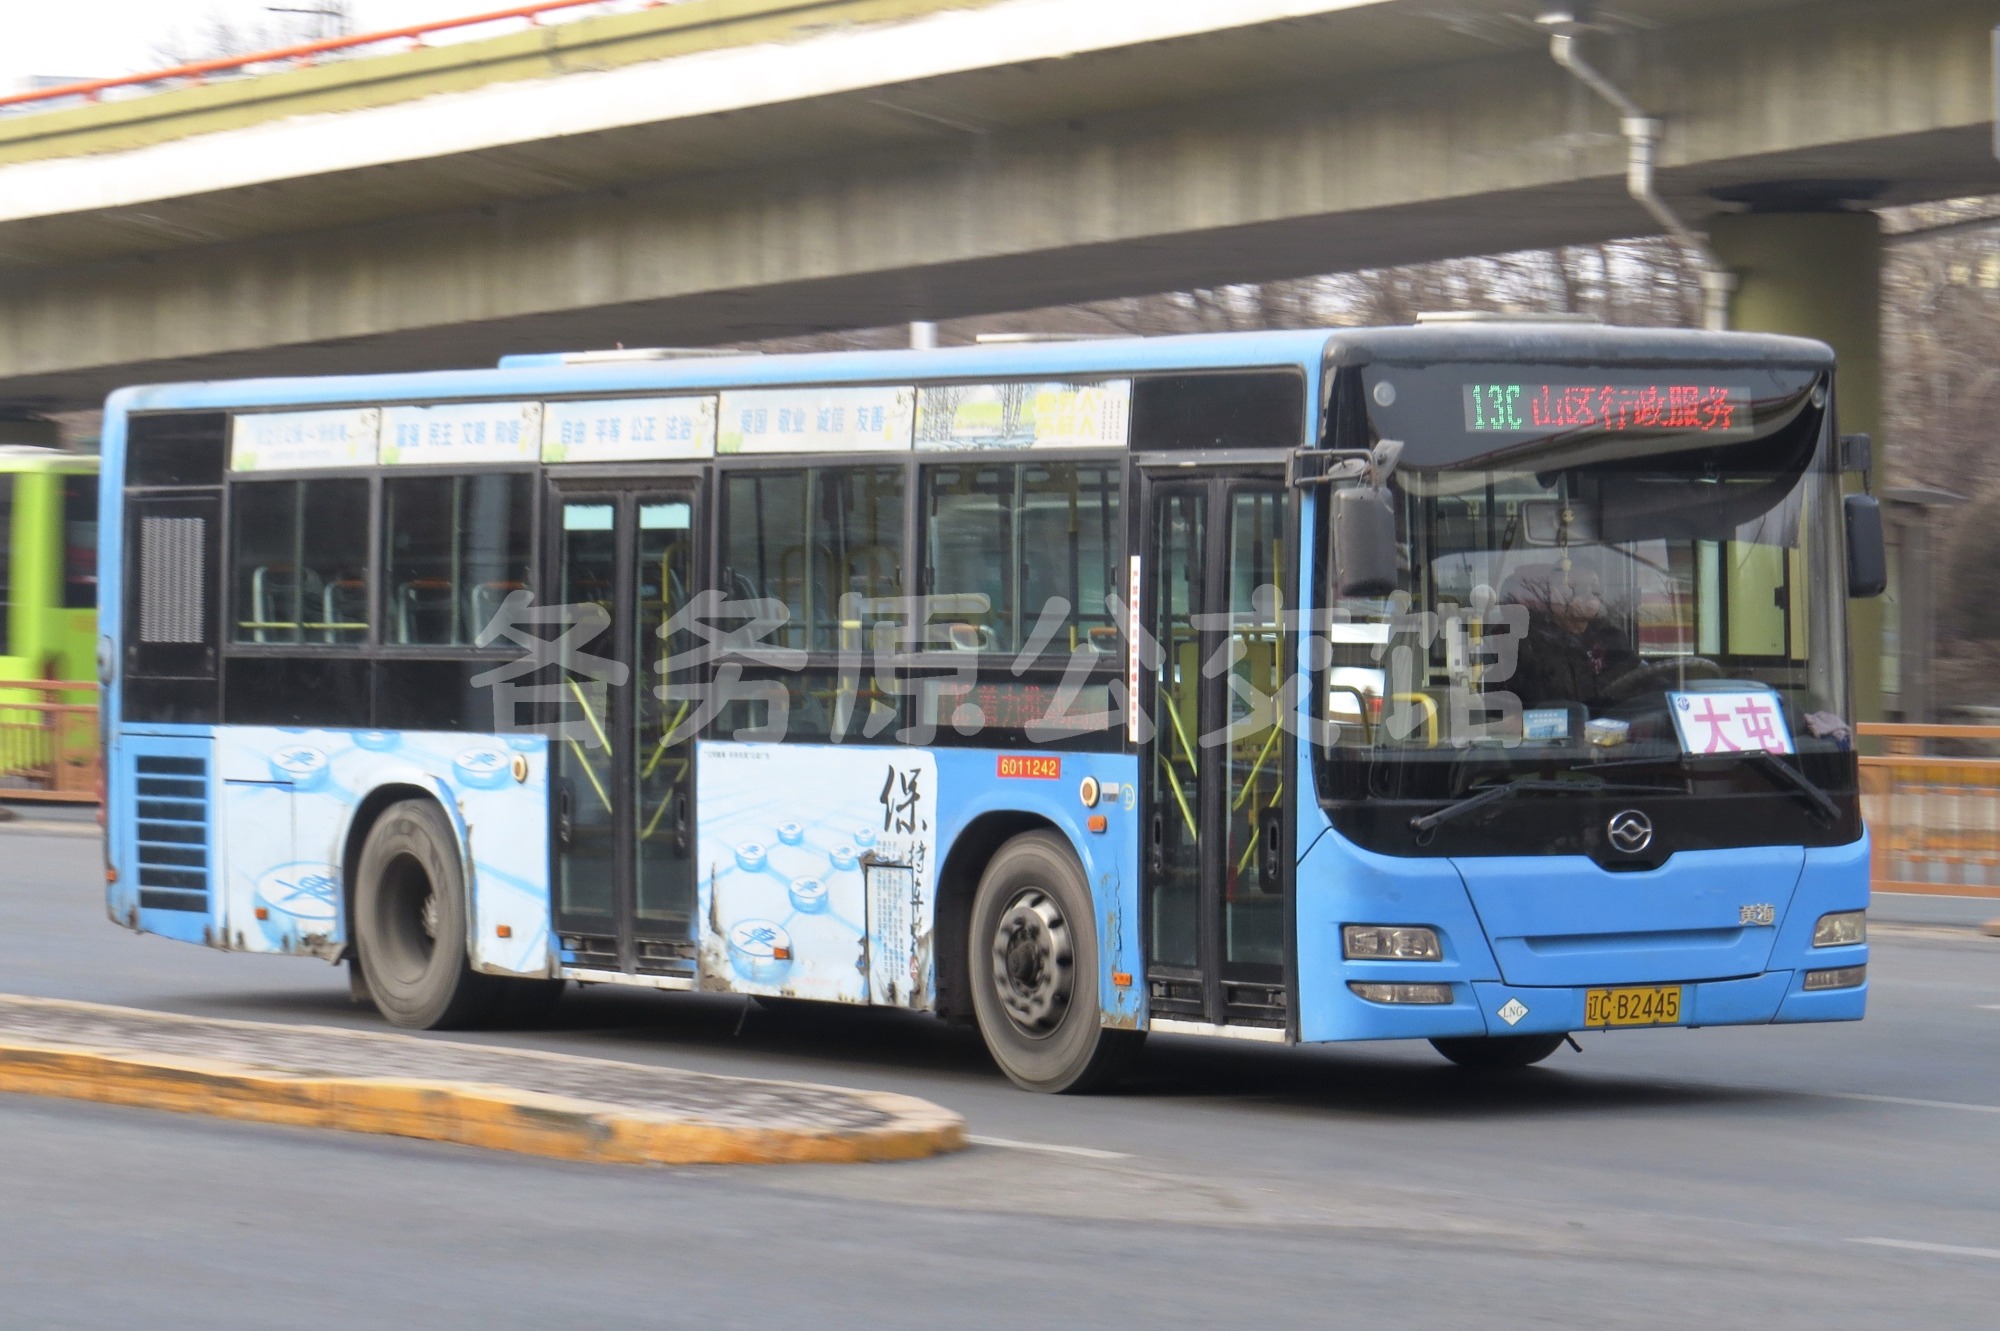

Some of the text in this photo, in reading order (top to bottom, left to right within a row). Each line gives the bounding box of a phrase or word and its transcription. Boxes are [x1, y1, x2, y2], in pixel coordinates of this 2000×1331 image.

[857, 406, 885, 432] 友善
[1472, 385, 1522, 430] 13C
[1693, 697, 1785, 756] 大屯
[1001, 758, 1057, 777] 6011242
[1503, 1006, 1523, 1018] LNG
